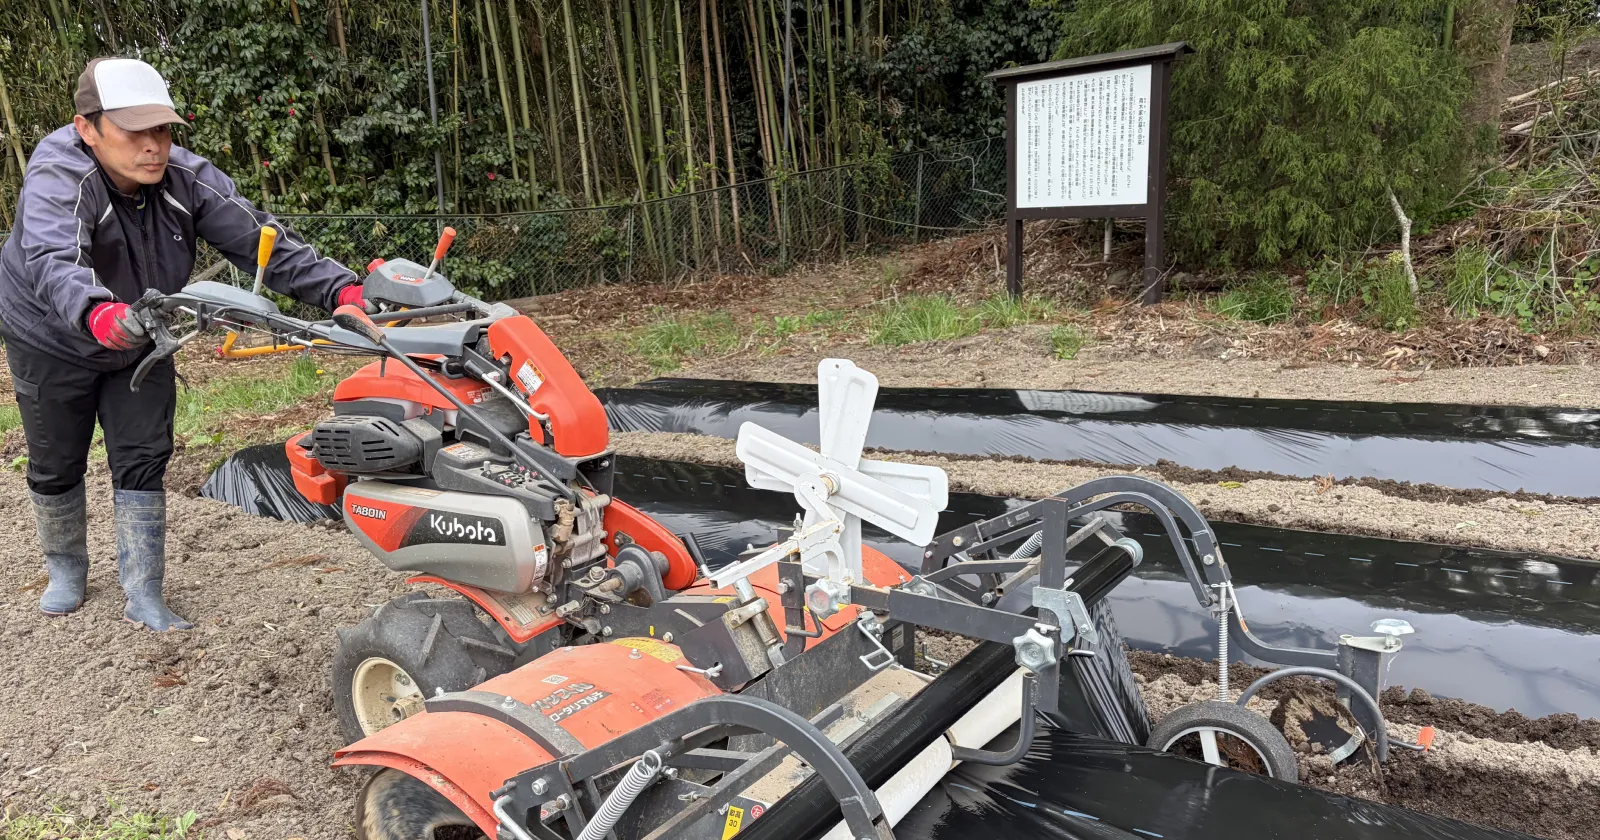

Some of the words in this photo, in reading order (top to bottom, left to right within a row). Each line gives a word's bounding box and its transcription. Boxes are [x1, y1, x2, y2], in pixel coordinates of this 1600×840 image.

[351, 503, 387, 521] TA801N
[430, 513, 496, 543] Kubota
[549, 690, 604, 722] ロータリマルチ
[728, 819, 738, 828] 30
